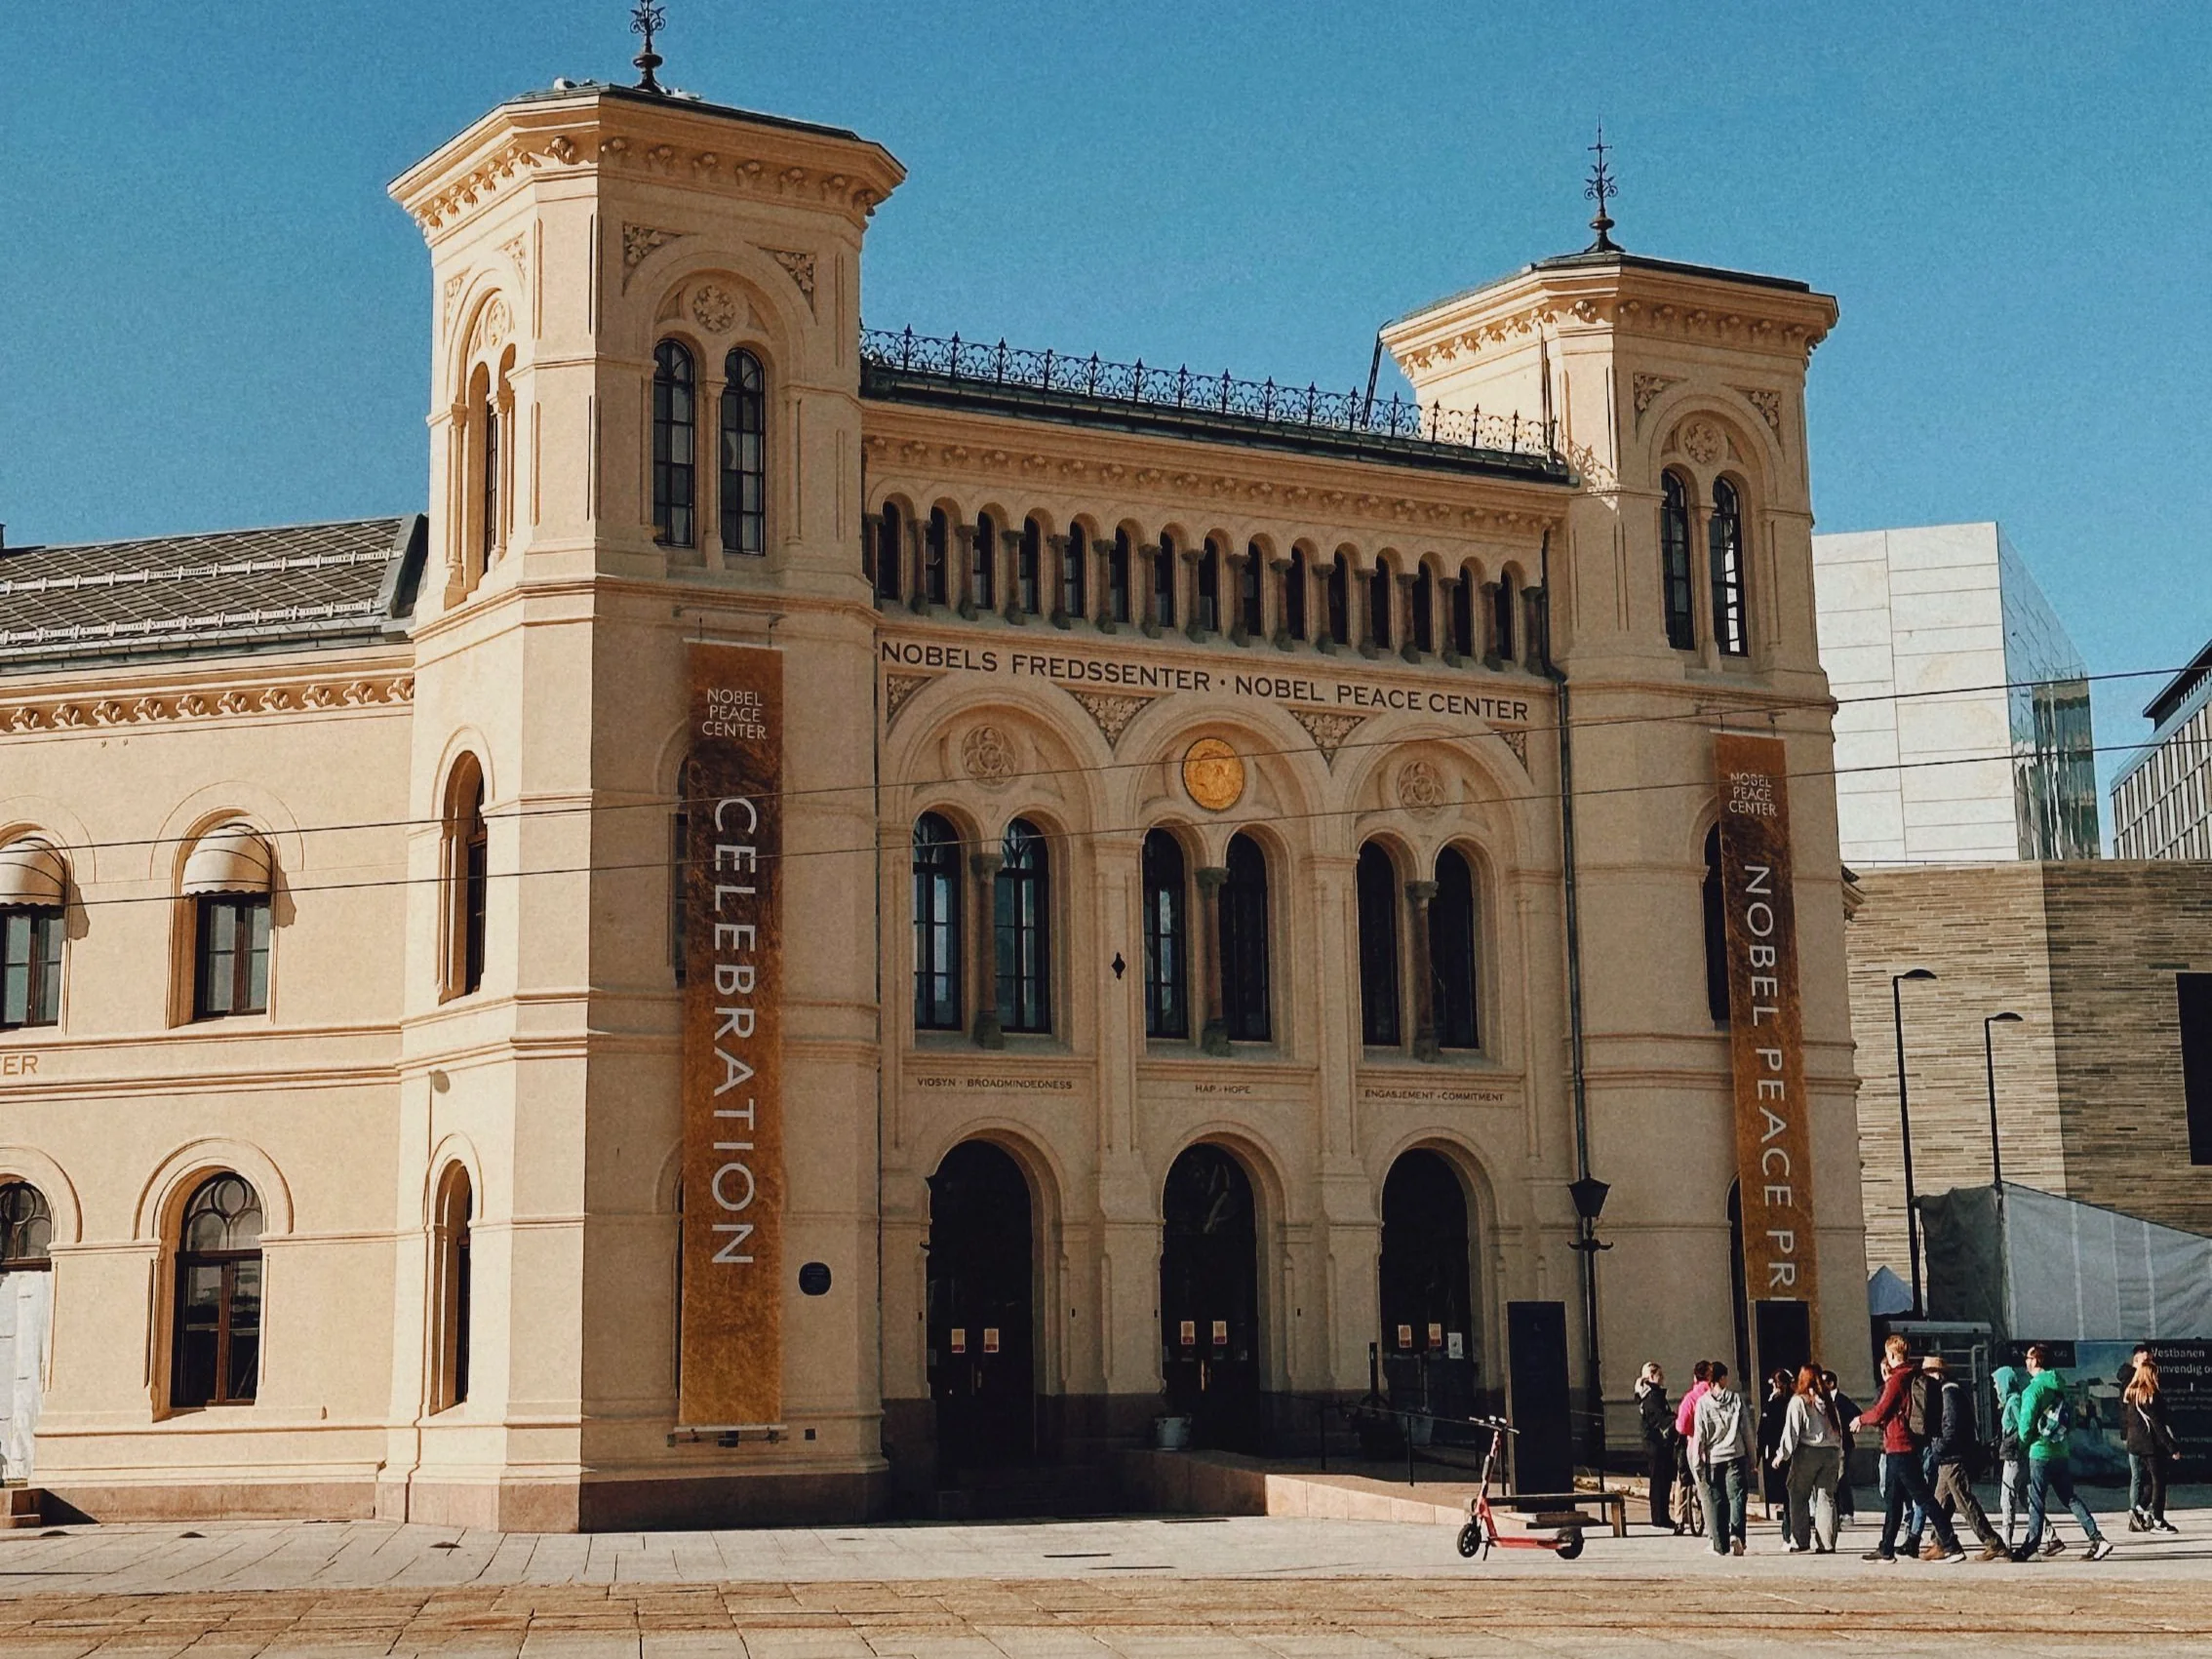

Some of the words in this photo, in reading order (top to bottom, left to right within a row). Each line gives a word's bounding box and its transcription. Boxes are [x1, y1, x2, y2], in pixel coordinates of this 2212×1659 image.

[881, 641, 998, 672] NOBELS
[1011, 653, 1210, 691] FREDSSENTER
[1235, 674, 1324, 702] NOBEL
[1336, 684, 1422, 711] PEACE
[1429, 693, 1528, 721] CENTER
[707, 689, 763, 706] NOBEL
[709, 705, 761, 722] PEACE
[702, 721, 767, 739] CENTER
[1730, 772, 1771, 787] NOBEL
[1733, 786, 1771, 802] PEACE
[1728, 800, 1777, 816] CENTER
[1744, 865, 1778, 1027] NOBEL
[711, 797, 757, 1263] CELEBRATION
[0, 1054, 38, 1075] ER
[917, 1078, 956, 1087] VIDSYN
[967, 1078, 1073, 1089] BROADMINDEDNESS
[1224, 1085, 1251, 1094] HOPE
[1364, 1088, 1434, 1100] ENGASJEMENT
[1443, 1091, 1504, 1102] COMMITMENT
[1756, 1047, 1792, 1208] PEACE
[2155, 1363, 2202, 1376] nnvendig
